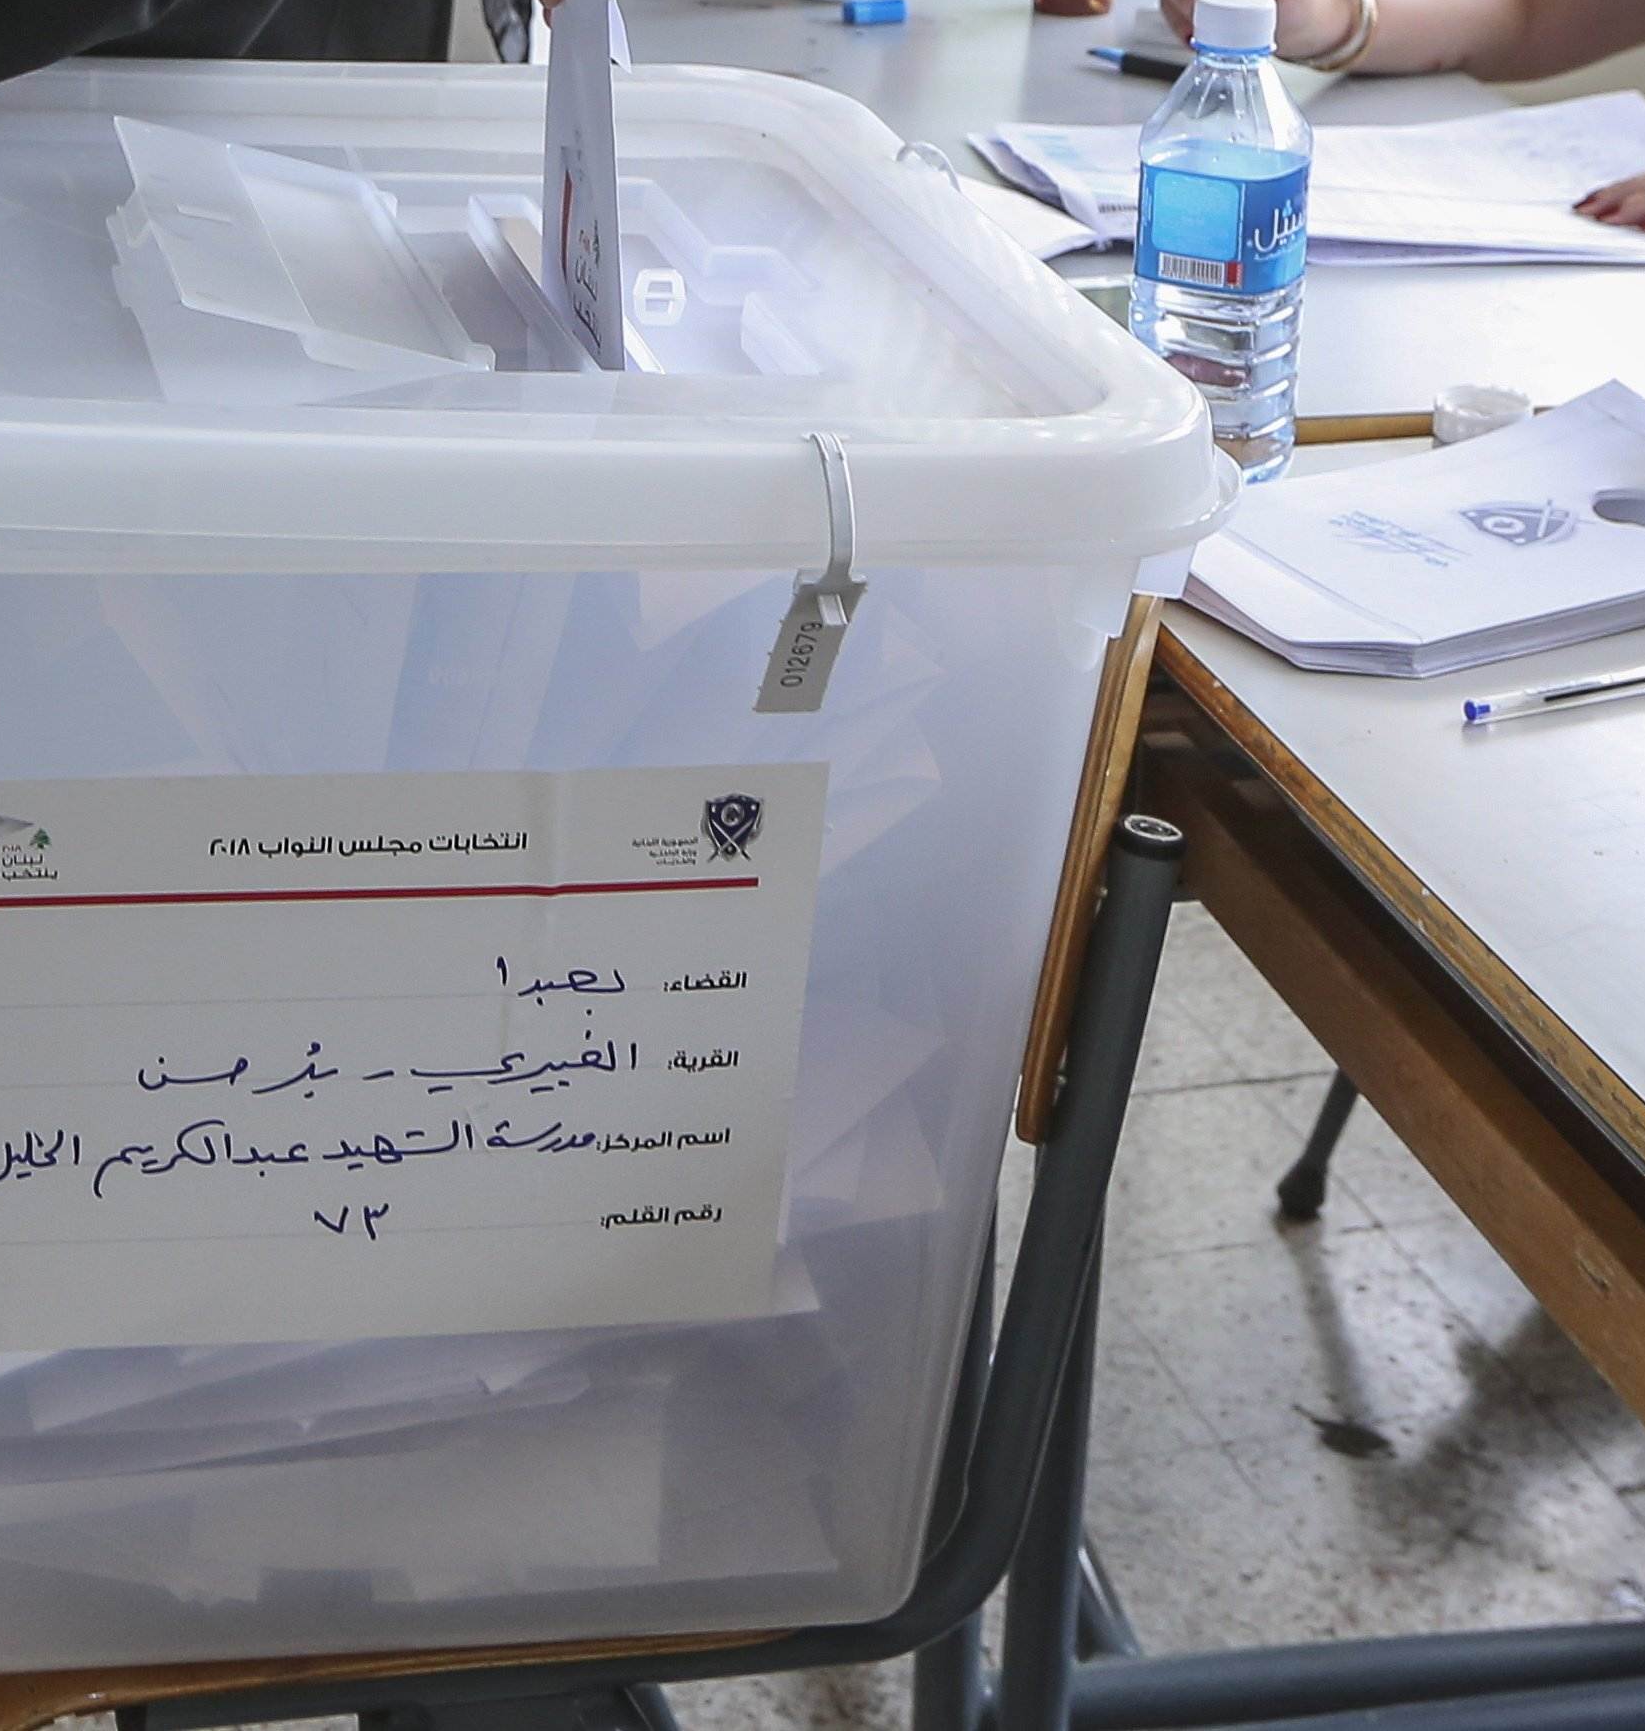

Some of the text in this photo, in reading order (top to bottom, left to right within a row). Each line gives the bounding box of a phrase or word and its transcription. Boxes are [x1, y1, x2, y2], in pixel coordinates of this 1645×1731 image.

[779, 622, 823, 688] 012679
[209, 832, 528, 859] انتخابات مجلس النواب ٢٠١٨
[1, 853, 44, 868] لبنان
[1, 868, 59, 882] ينتخب
[663, 970, 748, 993] القضاء:
[667, 1048, 740, 1073] القرية:
[323, 1120, 474, 1170] الشهيد
[485, 1120, 597, 1153] مدرسة
[596, 1130, 673, 1154] المركز:
[676, 1127, 731, 1150] اسم
[599, 1204, 669, 1229] القلم:
[673, 1204, 723, 1228] رقم
